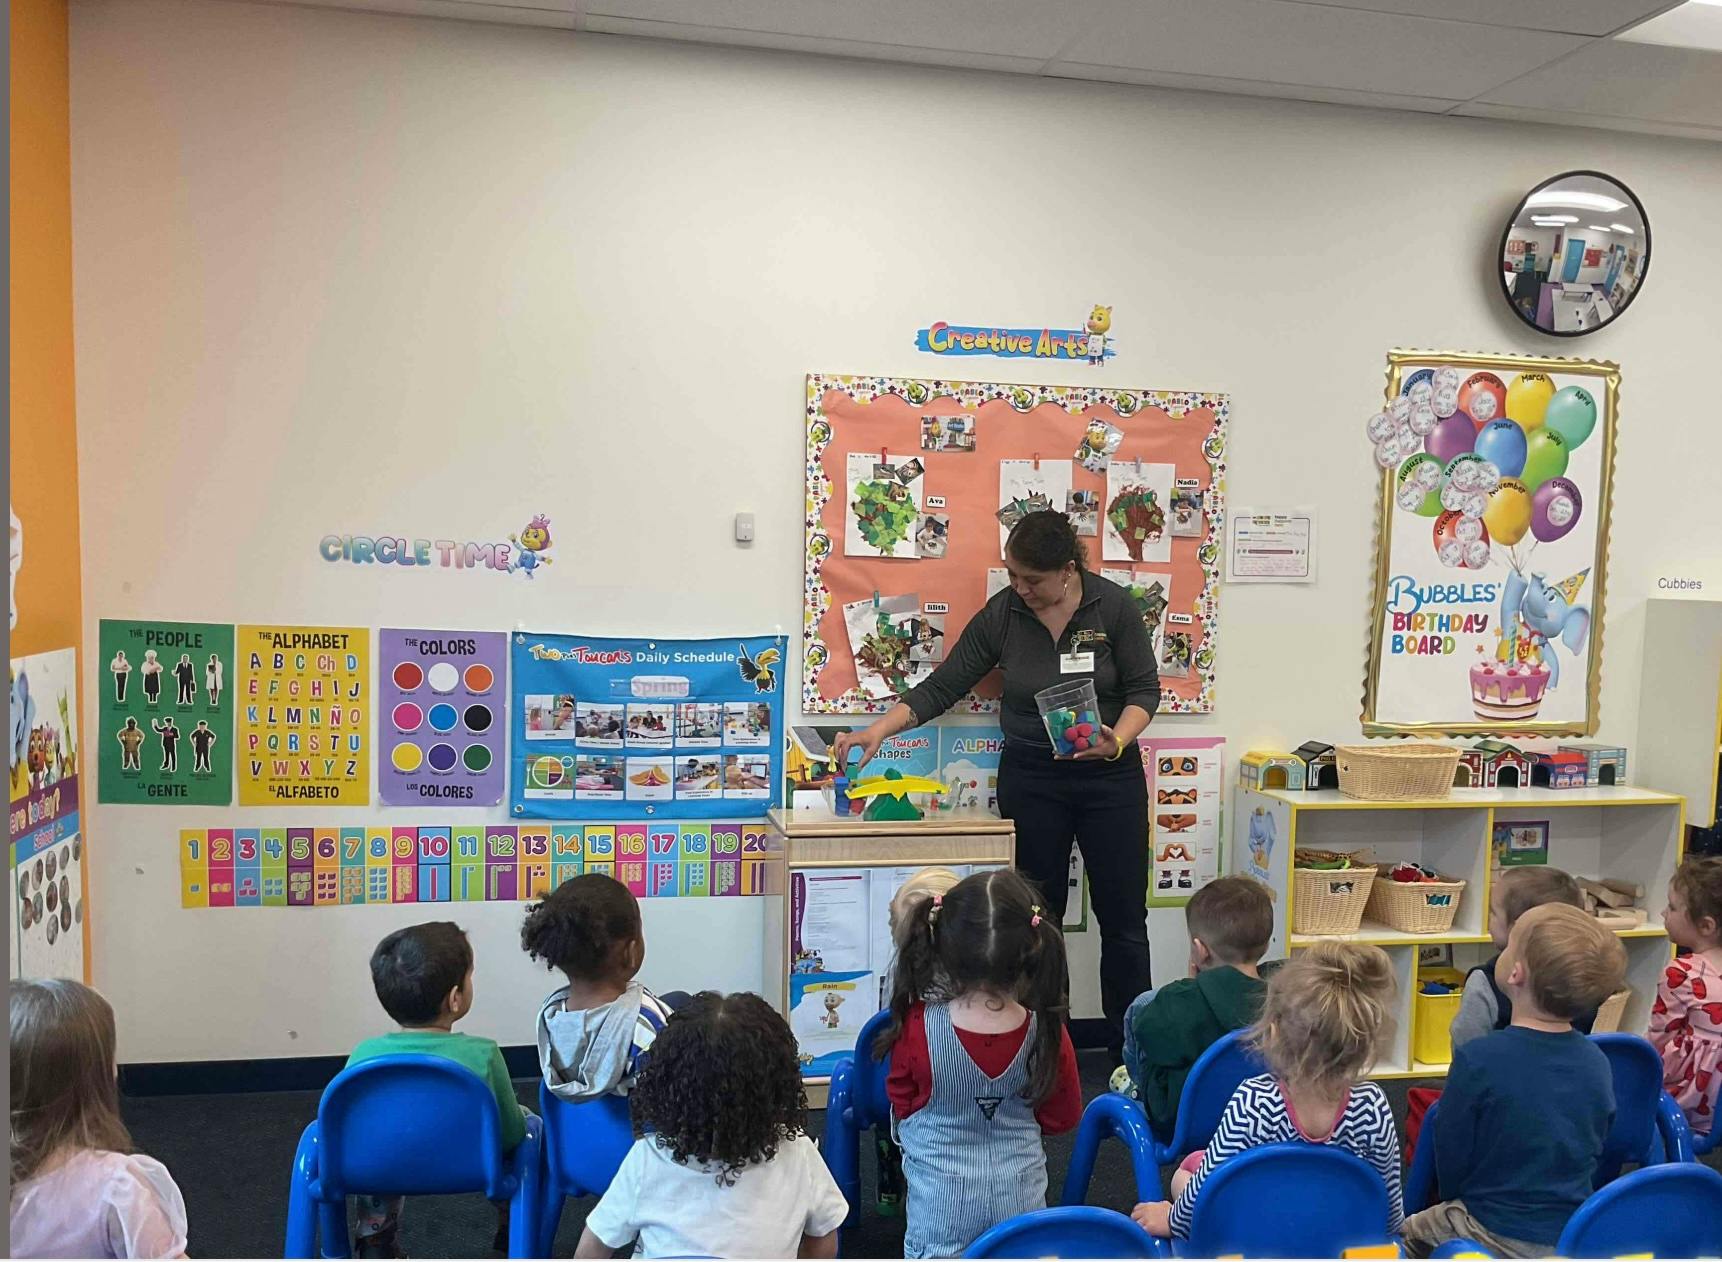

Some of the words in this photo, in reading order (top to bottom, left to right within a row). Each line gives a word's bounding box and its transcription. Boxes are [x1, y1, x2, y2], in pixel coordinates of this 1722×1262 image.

[928, 320, 1033, 352] Creative
[1036, 328, 1088, 358] Arts
[1467, 374, 1501, 389] February
[1521, 375, 1545, 383] March
[1574, 389, 1592, 407] April
[1493, 422, 1513, 431] June
[1546, 432, 1563, 447] July
[1400, 456, 1424, 482] August
[1445, 455, 1482, 478] September
[1488, 482, 1526, 498] November
[928, 497, 943, 505] Ava
[319, 535, 431, 566] CIRCLE
[435, 539, 511, 571] TIME
[1658, 577, 1702, 590] Cubbies
[1392, 611, 1489, 633] BIRTHDAY
[128, 629, 144, 638] THE
[146, 630, 203, 649] PEOPLE
[259, 632, 272, 641] THE
[272, 633, 349, 650] ALPHABET
[405, 638, 418, 647] THE
[419, 639, 476, 656] COLORS
[1391, 634, 1456, 655] BOARD
[250, 653, 261, 669] A
[274, 653, 284, 669] B
[295, 654, 305, 670] C
[317, 655, 336, 671] Ch
[347, 655, 357, 670] D
[636, 652, 670, 665] Daily
[674, 652, 735, 663] Schedule
[249, 679, 258, 695] E
[270, 680, 279, 695] F
[289, 681, 299, 695] G
[311, 681, 322, 696] H
[333, 680, 338, 695] I
[349, 683, 359, 697] J
[248, 706, 258, 722] K
[269, 707, 277, 723] L
[287, 707, 301, 724] M
[310, 708, 321, 724] N
[331, 705, 341, 725] Ñ
[350, 709, 360, 724] O
[249, 734, 259, 750] P
[267, 735, 279, 751] Q
[288, 734, 299, 750] R
[309, 735, 320, 750] S
[331, 735, 340, 750] T
[350, 735, 359, 751] U
[251, 760, 262, 776] V
[273, 760, 289, 775] W
[300, 760, 311, 775] X
[323, 760, 334, 775] Y
[346, 760, 356, 775] Z
[147, 784, 188, 797] GENTE
[276, 785, 339, 798] ALFABETO
[406, 783, 418, 791] LOS
[419, 784, 474, 799] COLORES
[28, 787, 61, 825] today?
[187, 839, 199, 860] 1
[211, 839, 231, 861] 2
[238, 838, 257, 860] 3
[264, 838, 283, 859] 4
[290, 837, 310, 859] 5
[317, 837, 336, 859] 6
[344, 836, 362, 859] 7
[369, 836, 387, 858] 8
[394, 836, 413, 858] 9
[419, 835, 449, 858] 10
[457, 835, 478, 857] 11
[488, 834, 515, 856] 12
[522, 834, 548, 856] 13
[553, 834, 581, 855] 14
[587, 834, 613, 855] 15
[620, 834, 644, 855] 16
[651, 833, 676, 854] 17
[682, 833, 707, 853] 18
[713, 832, 739, 853] 19
[743, 833, 766, 853] 20
